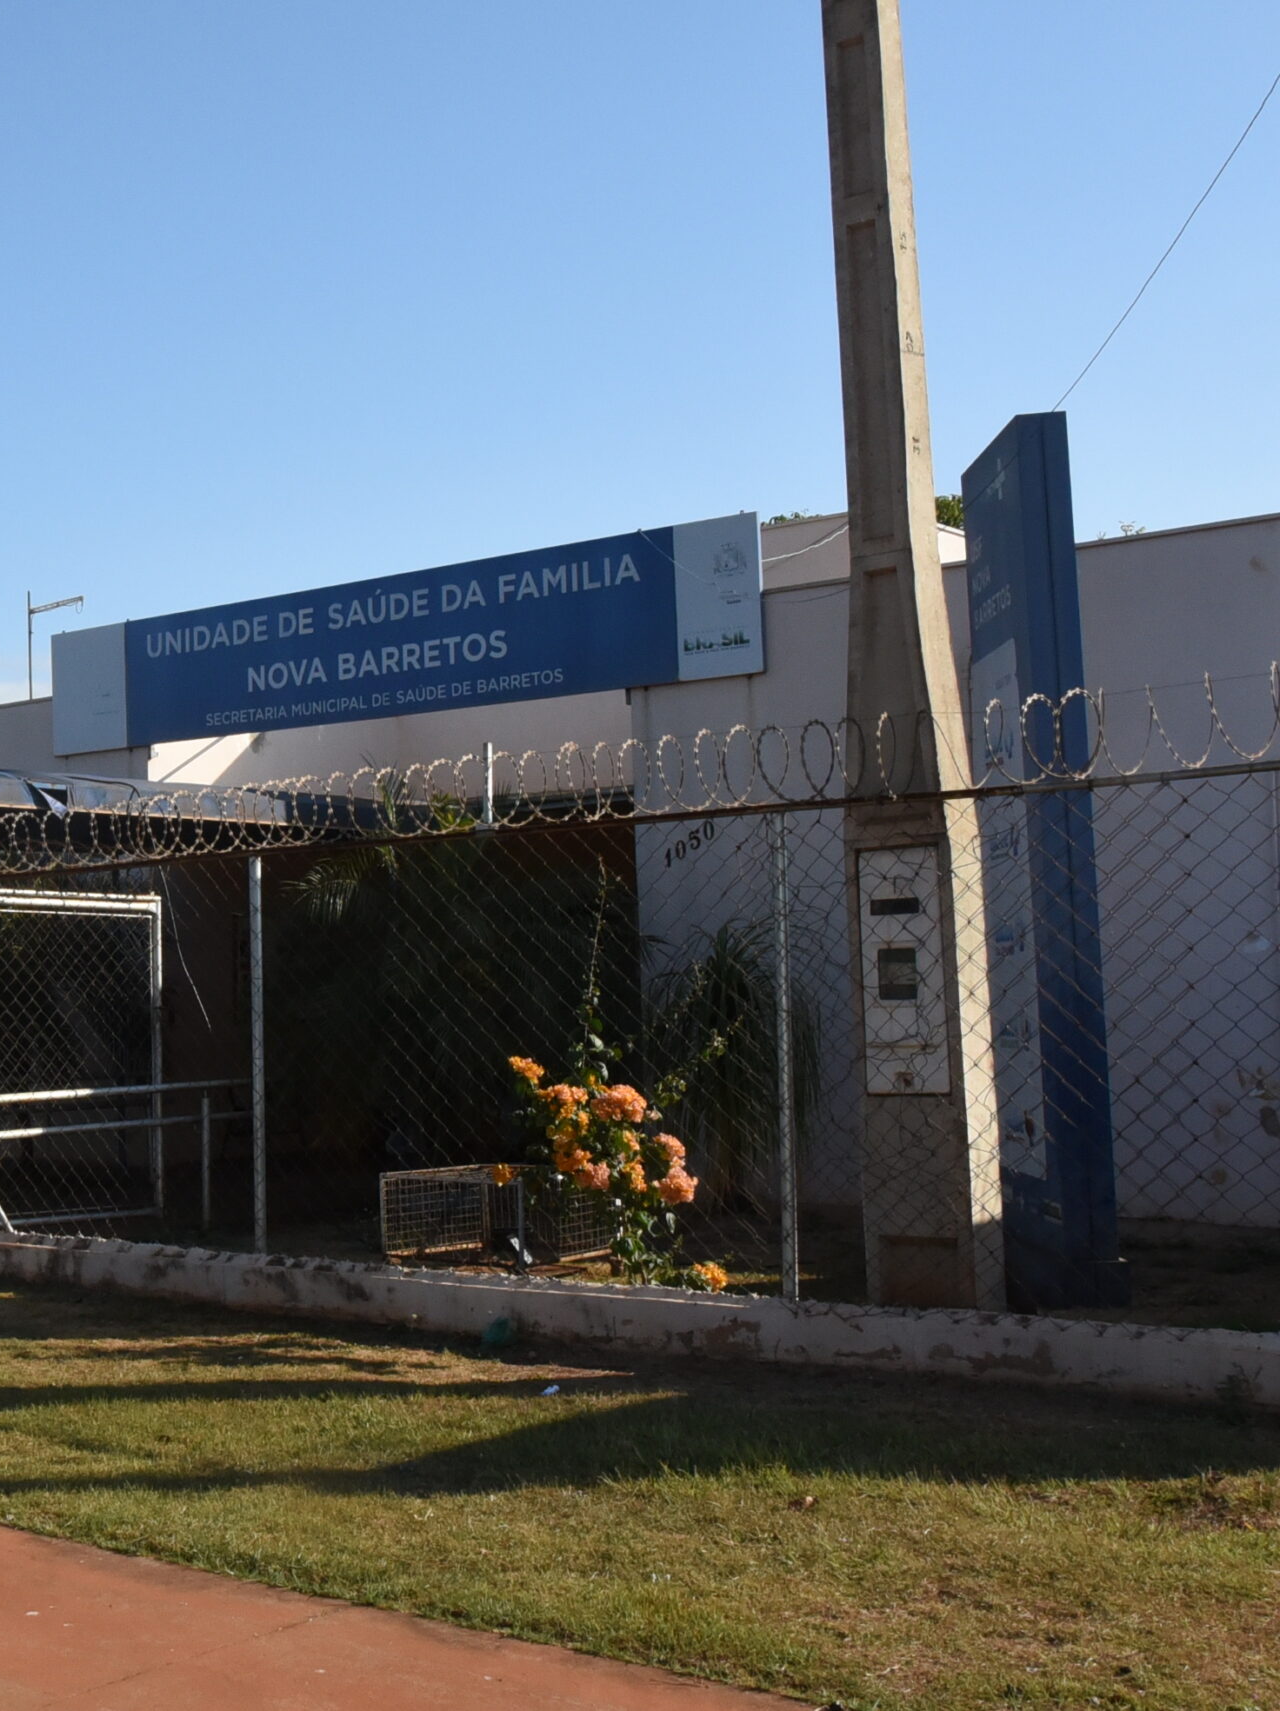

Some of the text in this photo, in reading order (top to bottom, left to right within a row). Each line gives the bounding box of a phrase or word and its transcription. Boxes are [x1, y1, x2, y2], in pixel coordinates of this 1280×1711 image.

[146, 554, 640, 658] UNIDADE DE SAÚDE DA FAMILIA
[247, 630, 509, 692] NOVA BARRETOS
[205, 668, 564, 726] SECRETARIA MUNICIPAL DE SAÚDE DE BARRETOS
[664, 820, 715, 868] 1050
